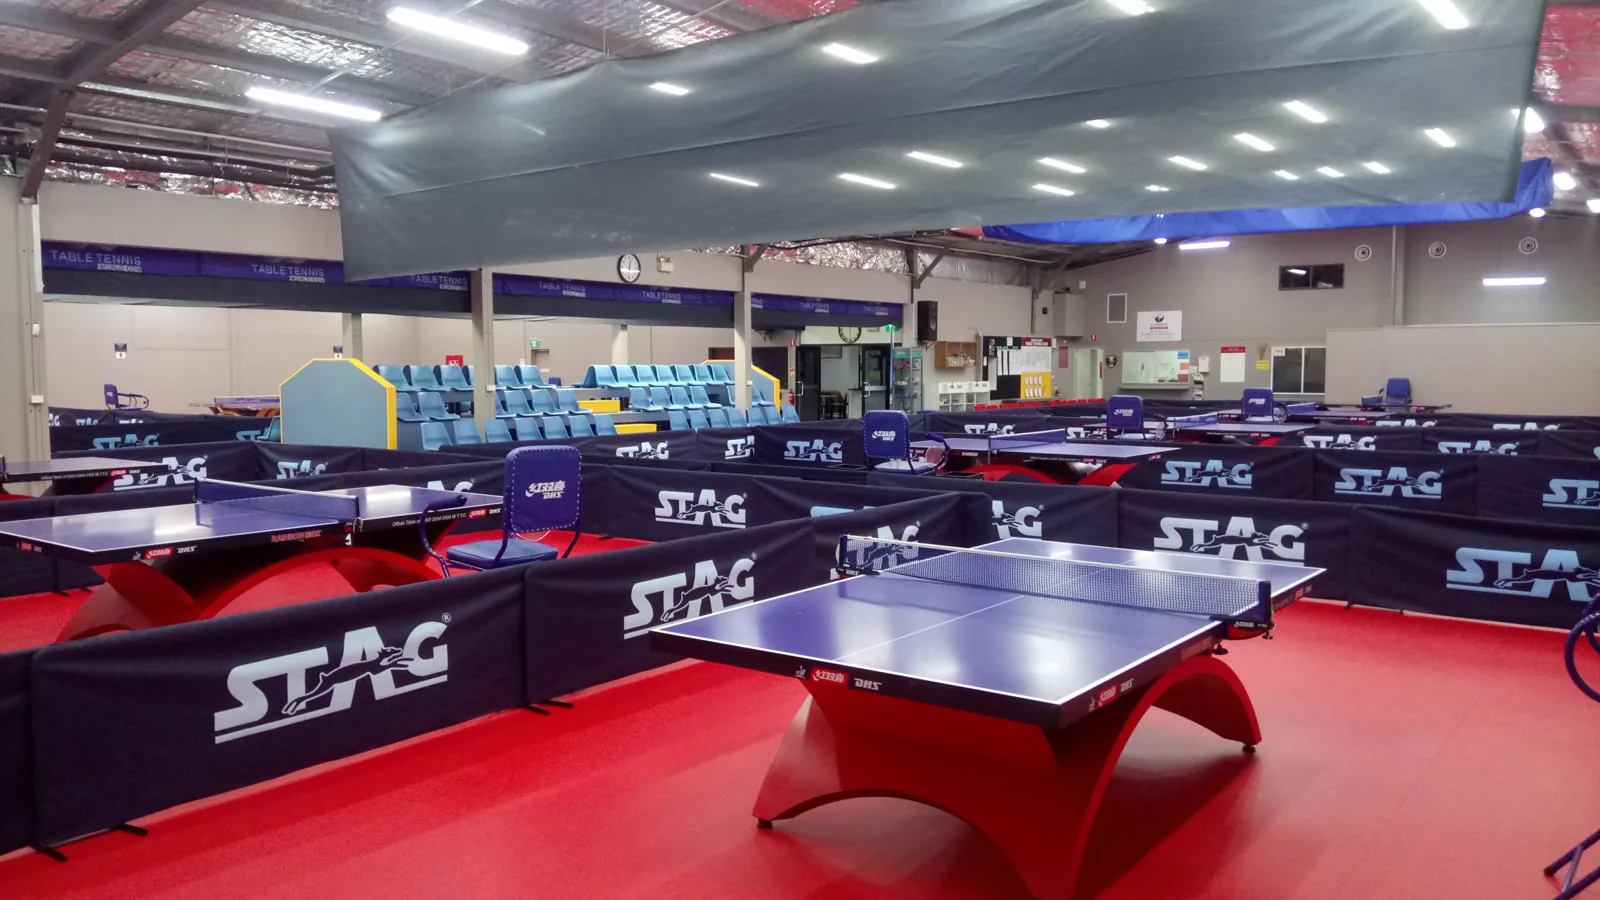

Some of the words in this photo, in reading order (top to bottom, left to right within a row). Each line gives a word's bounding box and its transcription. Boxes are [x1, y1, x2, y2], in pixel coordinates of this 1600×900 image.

[50, 250, 93, 263] TABLE
[95, 253, 141, 265] TENNIS
[252, 264, 286, 275] TABLE
[288, 266, 324, 277] TENNIS
[539, 282, 561, 291] TABLE
[724, 435, 755, 460] STA
[784, 439, 843, 463] STAG
[1160, 459, 1253, 489] STAG
[1334, 466, 1443, 499] STAG
[655, 488, 746, 528] STAG
[1542, 478, 1600, 509] ST
[177, 545, 197, 554] DHS
[1153, 515, 1305, 566] STAG
[1446, 547, 1600, 602] STA
[624, 558, 755, 640] STAG
[214, 621, 449, 744] STAG
[853, 677, 882, 691] DHS
